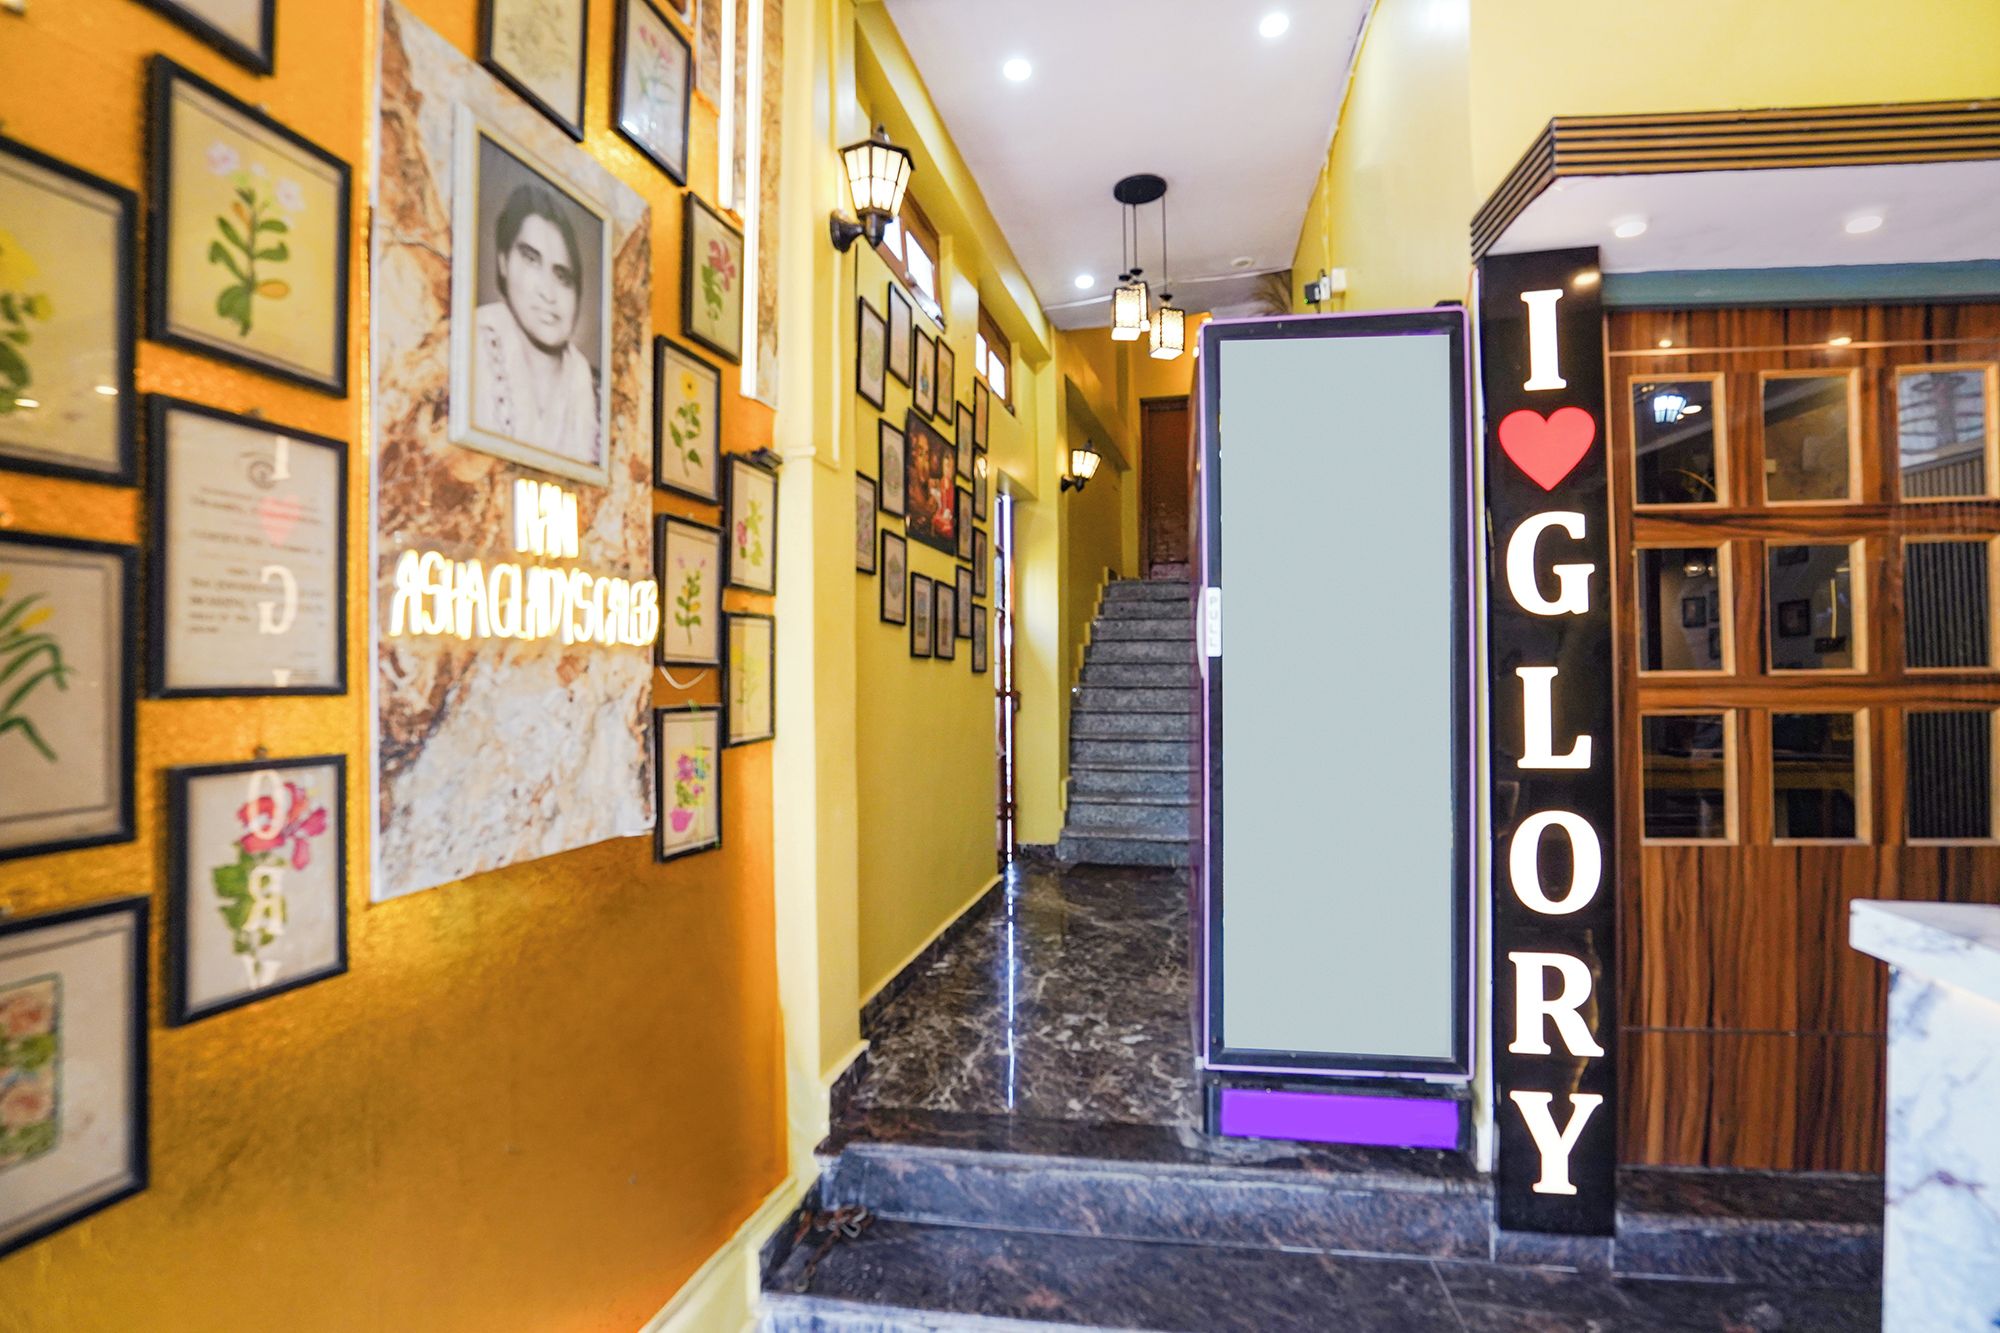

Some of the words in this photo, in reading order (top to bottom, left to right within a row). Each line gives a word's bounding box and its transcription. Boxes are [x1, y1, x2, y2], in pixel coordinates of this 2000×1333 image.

[1520, 288, 1567, 391] I
[389, 549, 491, 640] ASHA
[1209, 595, 1219, 648] PULL
[1506, 511, 1605, 1195] GLORY
